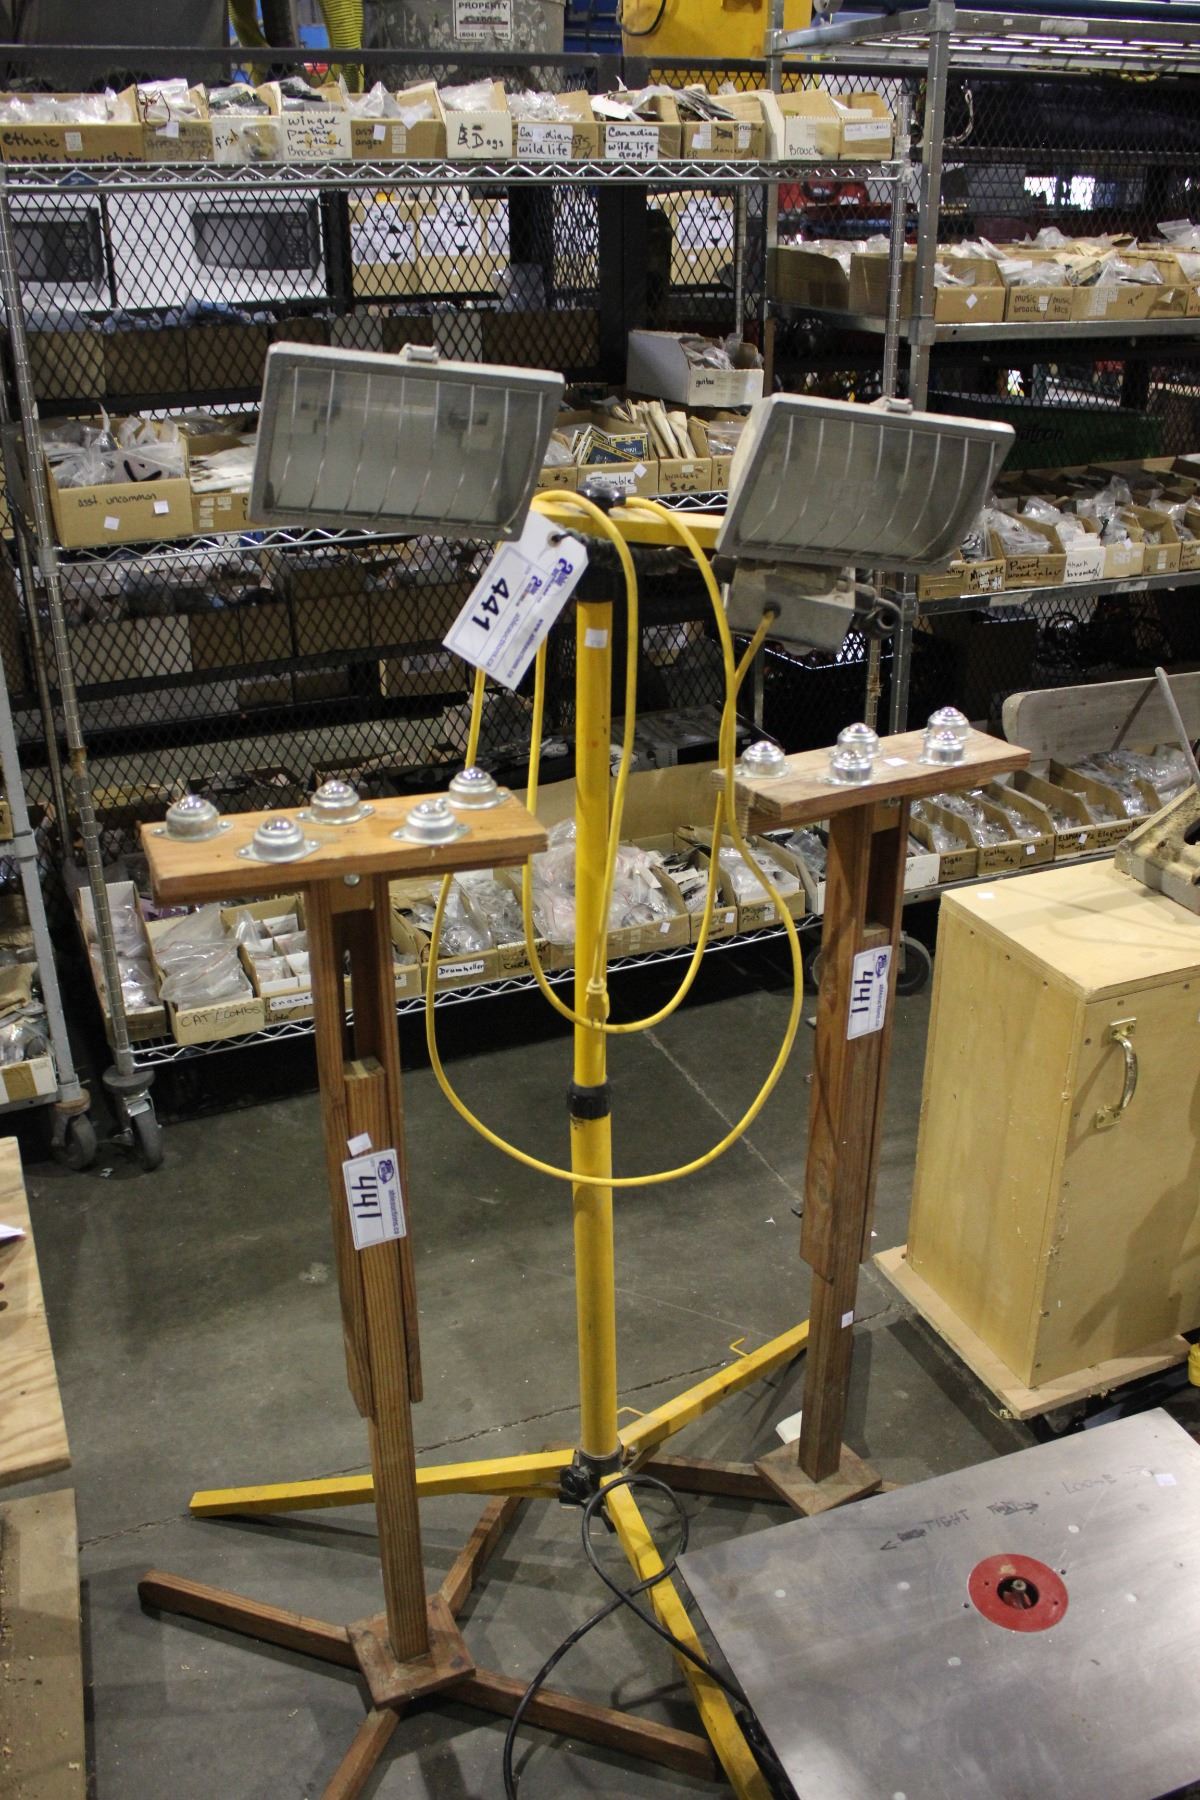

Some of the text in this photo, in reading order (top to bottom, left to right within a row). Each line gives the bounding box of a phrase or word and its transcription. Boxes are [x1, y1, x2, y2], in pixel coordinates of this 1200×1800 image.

[458, 2, 508, 10] PROPERTY
[288, 116, 337, 129] winged
[519, 126, 573, 141] Cadian
[608, 125, 658, 137] Canadian
[2, 132, 59, 148] ethnic
[471, 132, 504, 150] Dogs
[471, 577, 510, 632] 441
[438, 962, 484, 977] Drumheller
[851, 970, 874, 1014] 441
[181, 1012, 211, 1028] CAT
[351, 1176, 382, 1218] 441
[922, 1508, 970, 1531] TIGHT
